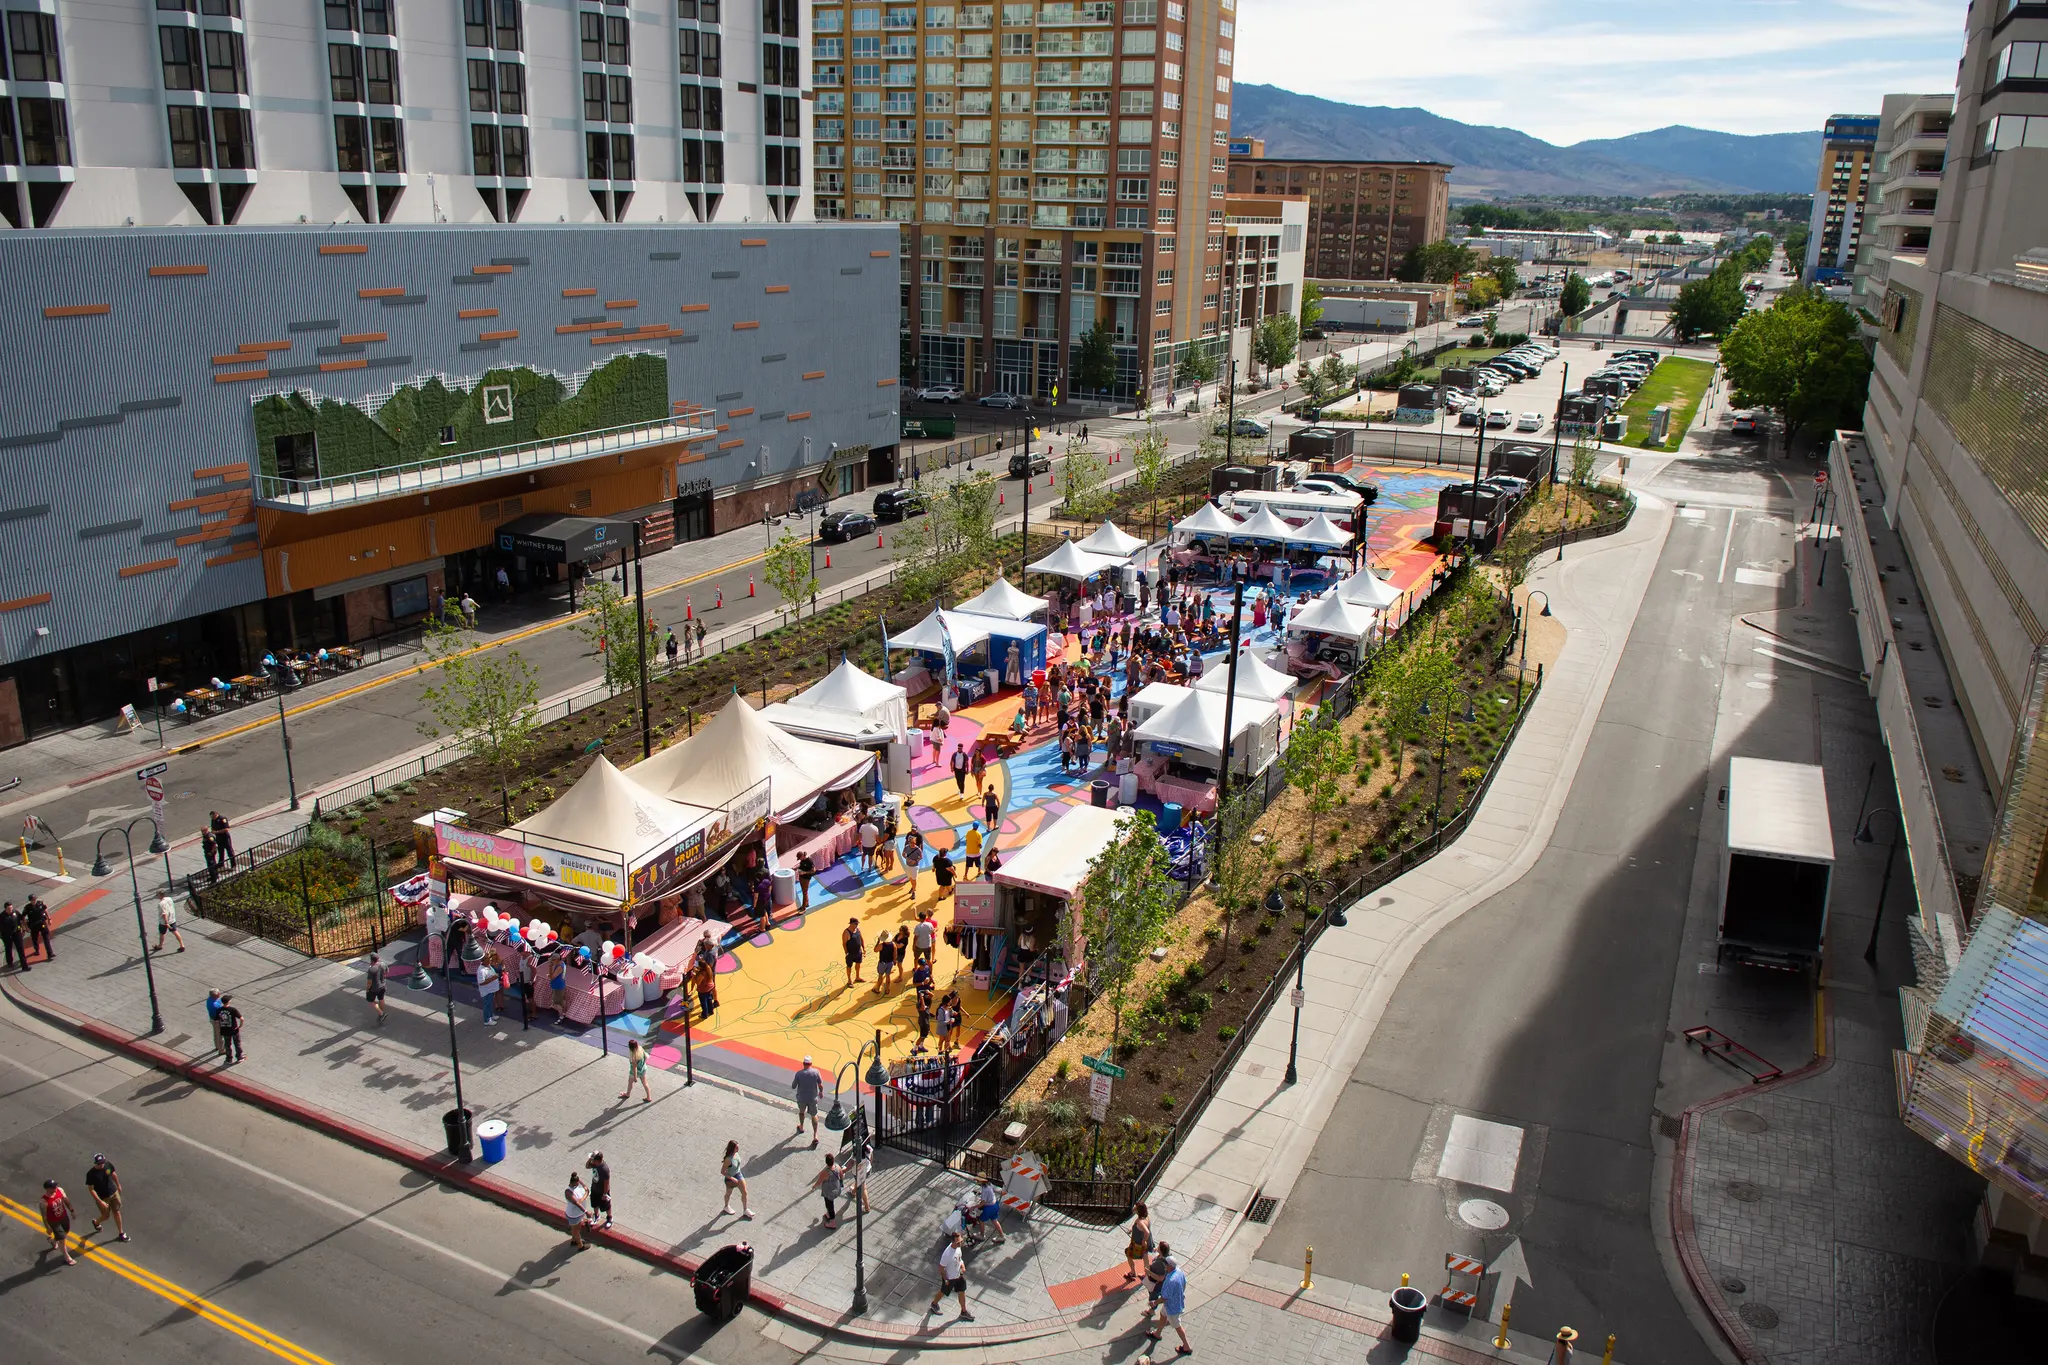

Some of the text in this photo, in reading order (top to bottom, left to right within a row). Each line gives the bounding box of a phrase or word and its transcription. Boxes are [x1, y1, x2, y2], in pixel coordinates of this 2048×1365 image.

[516, 539, 564, 552] WHITNEY PEAK
[583, 542, 606, 552] WHITNEY
[605, 538, 618, 547] PEAK
[441, 825, 495, 852] Breezy
[674, 832, 701, 855] FRESH
[448, 841, 516, 872] Paloma
[675, 844, 701, 867] FRUIT
[560, 857, 617, 878] Blueberry Vodka
[560, 866, 618, 895] LEMONADE
